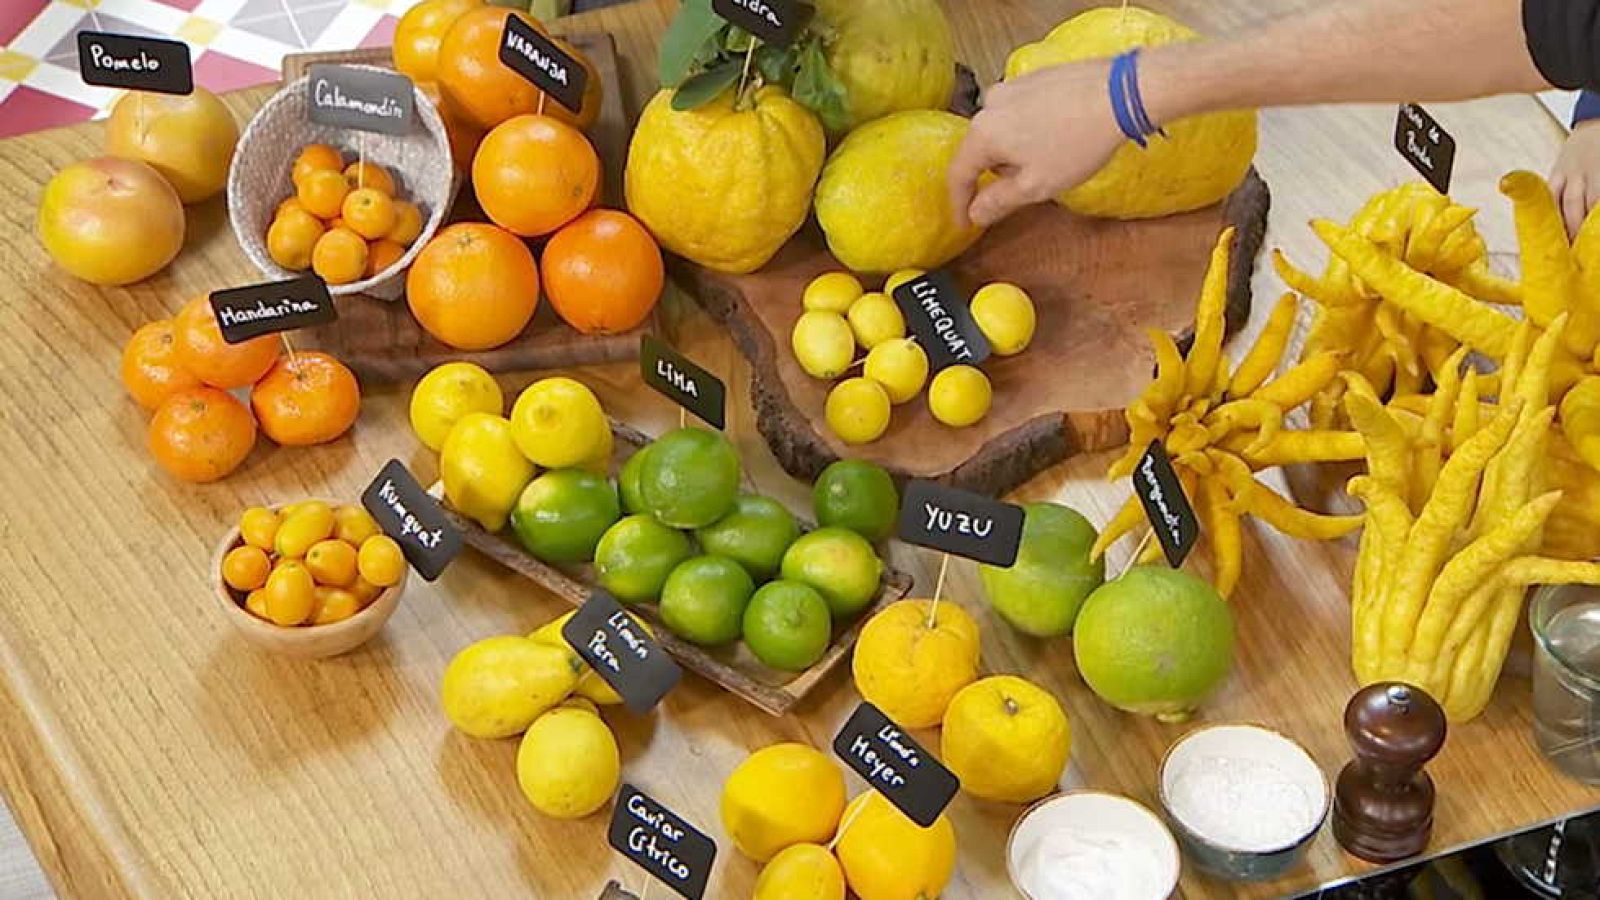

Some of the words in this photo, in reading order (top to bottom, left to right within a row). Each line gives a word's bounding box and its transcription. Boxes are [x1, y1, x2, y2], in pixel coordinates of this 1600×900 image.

[733, 0, 782, 27] idra
[91, 43, 160, 70] Pomelo
[507, 31, 568, 86] NARANJA
[220, 299, 318, 326] Mandarina
[378, 479, 443, 548] Kumquat
[924, 502, 994, 538] YUZU
[587, 629, 621, 672] Pera
[850, 734, 905, 786] Meyer
[627, 794, 685, 842] Caviar
